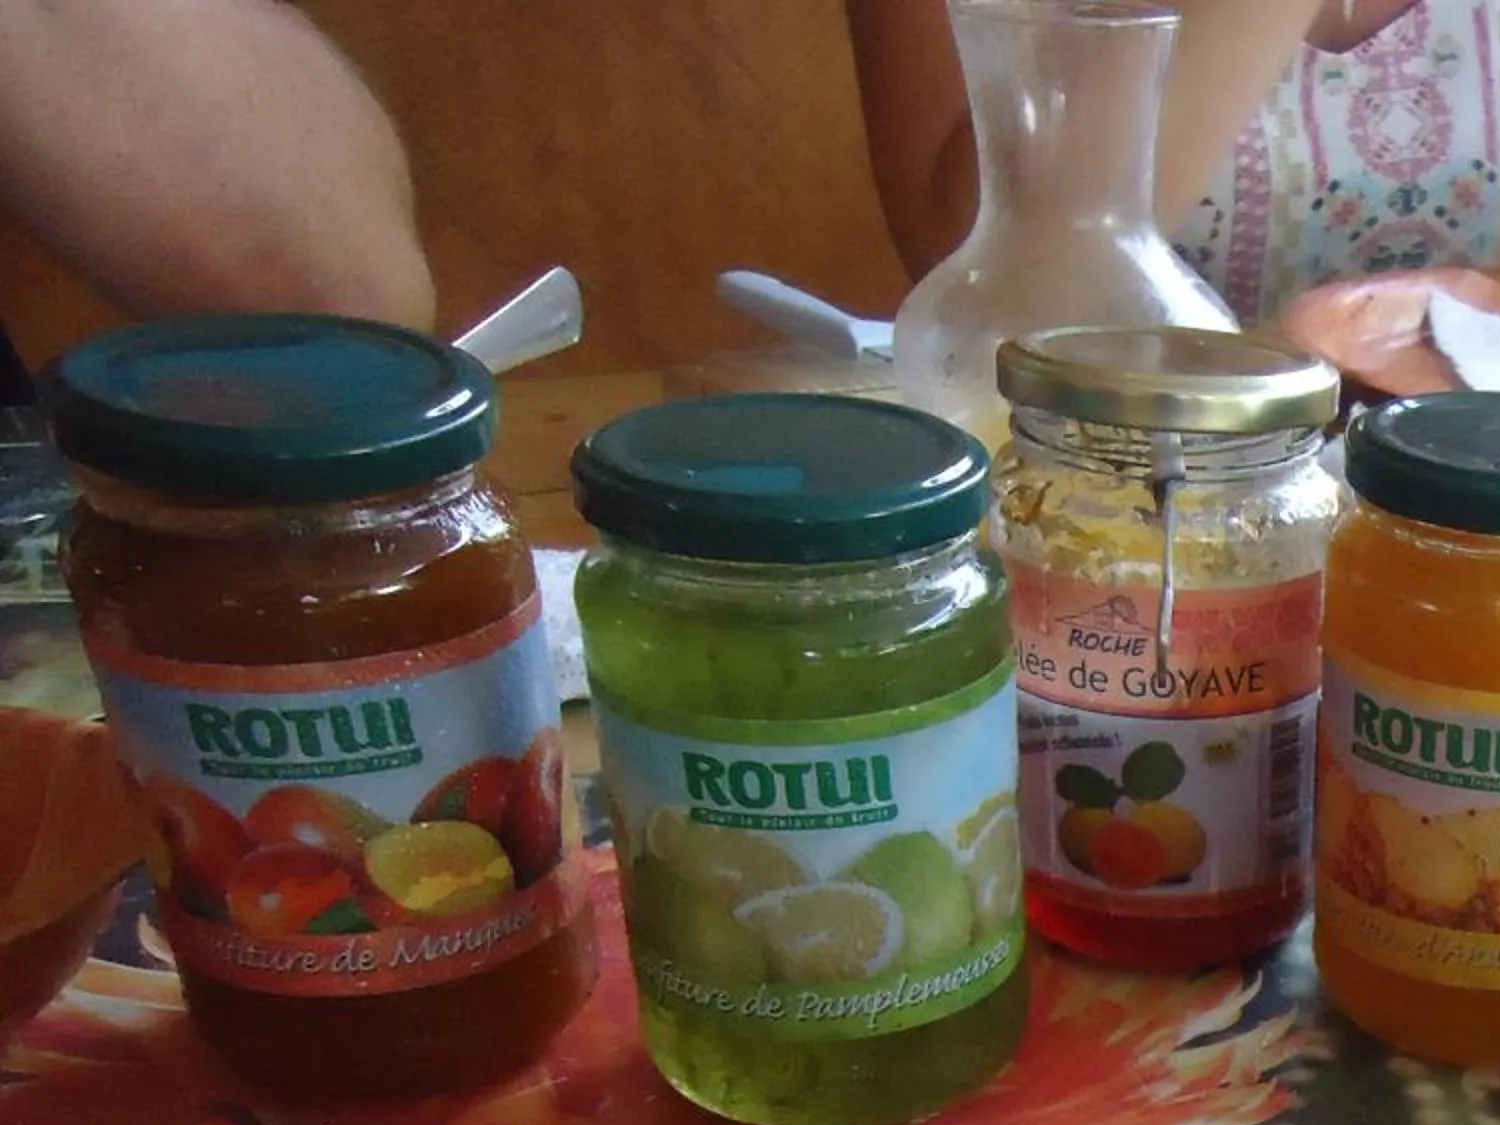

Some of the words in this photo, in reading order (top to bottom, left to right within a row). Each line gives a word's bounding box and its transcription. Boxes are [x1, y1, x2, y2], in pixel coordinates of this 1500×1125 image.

[1067, 628, 1150, 657] ROCHE
[1068, 659, 1109, 694] de
[1121, 661, 1266, 698] GOYAVE
[185, 697, 417, 758] ROTUI
[681, 751, 893, 810] ROTUI
[329, 934, 378, 973] de
[741, 983, 786, 1020] de
